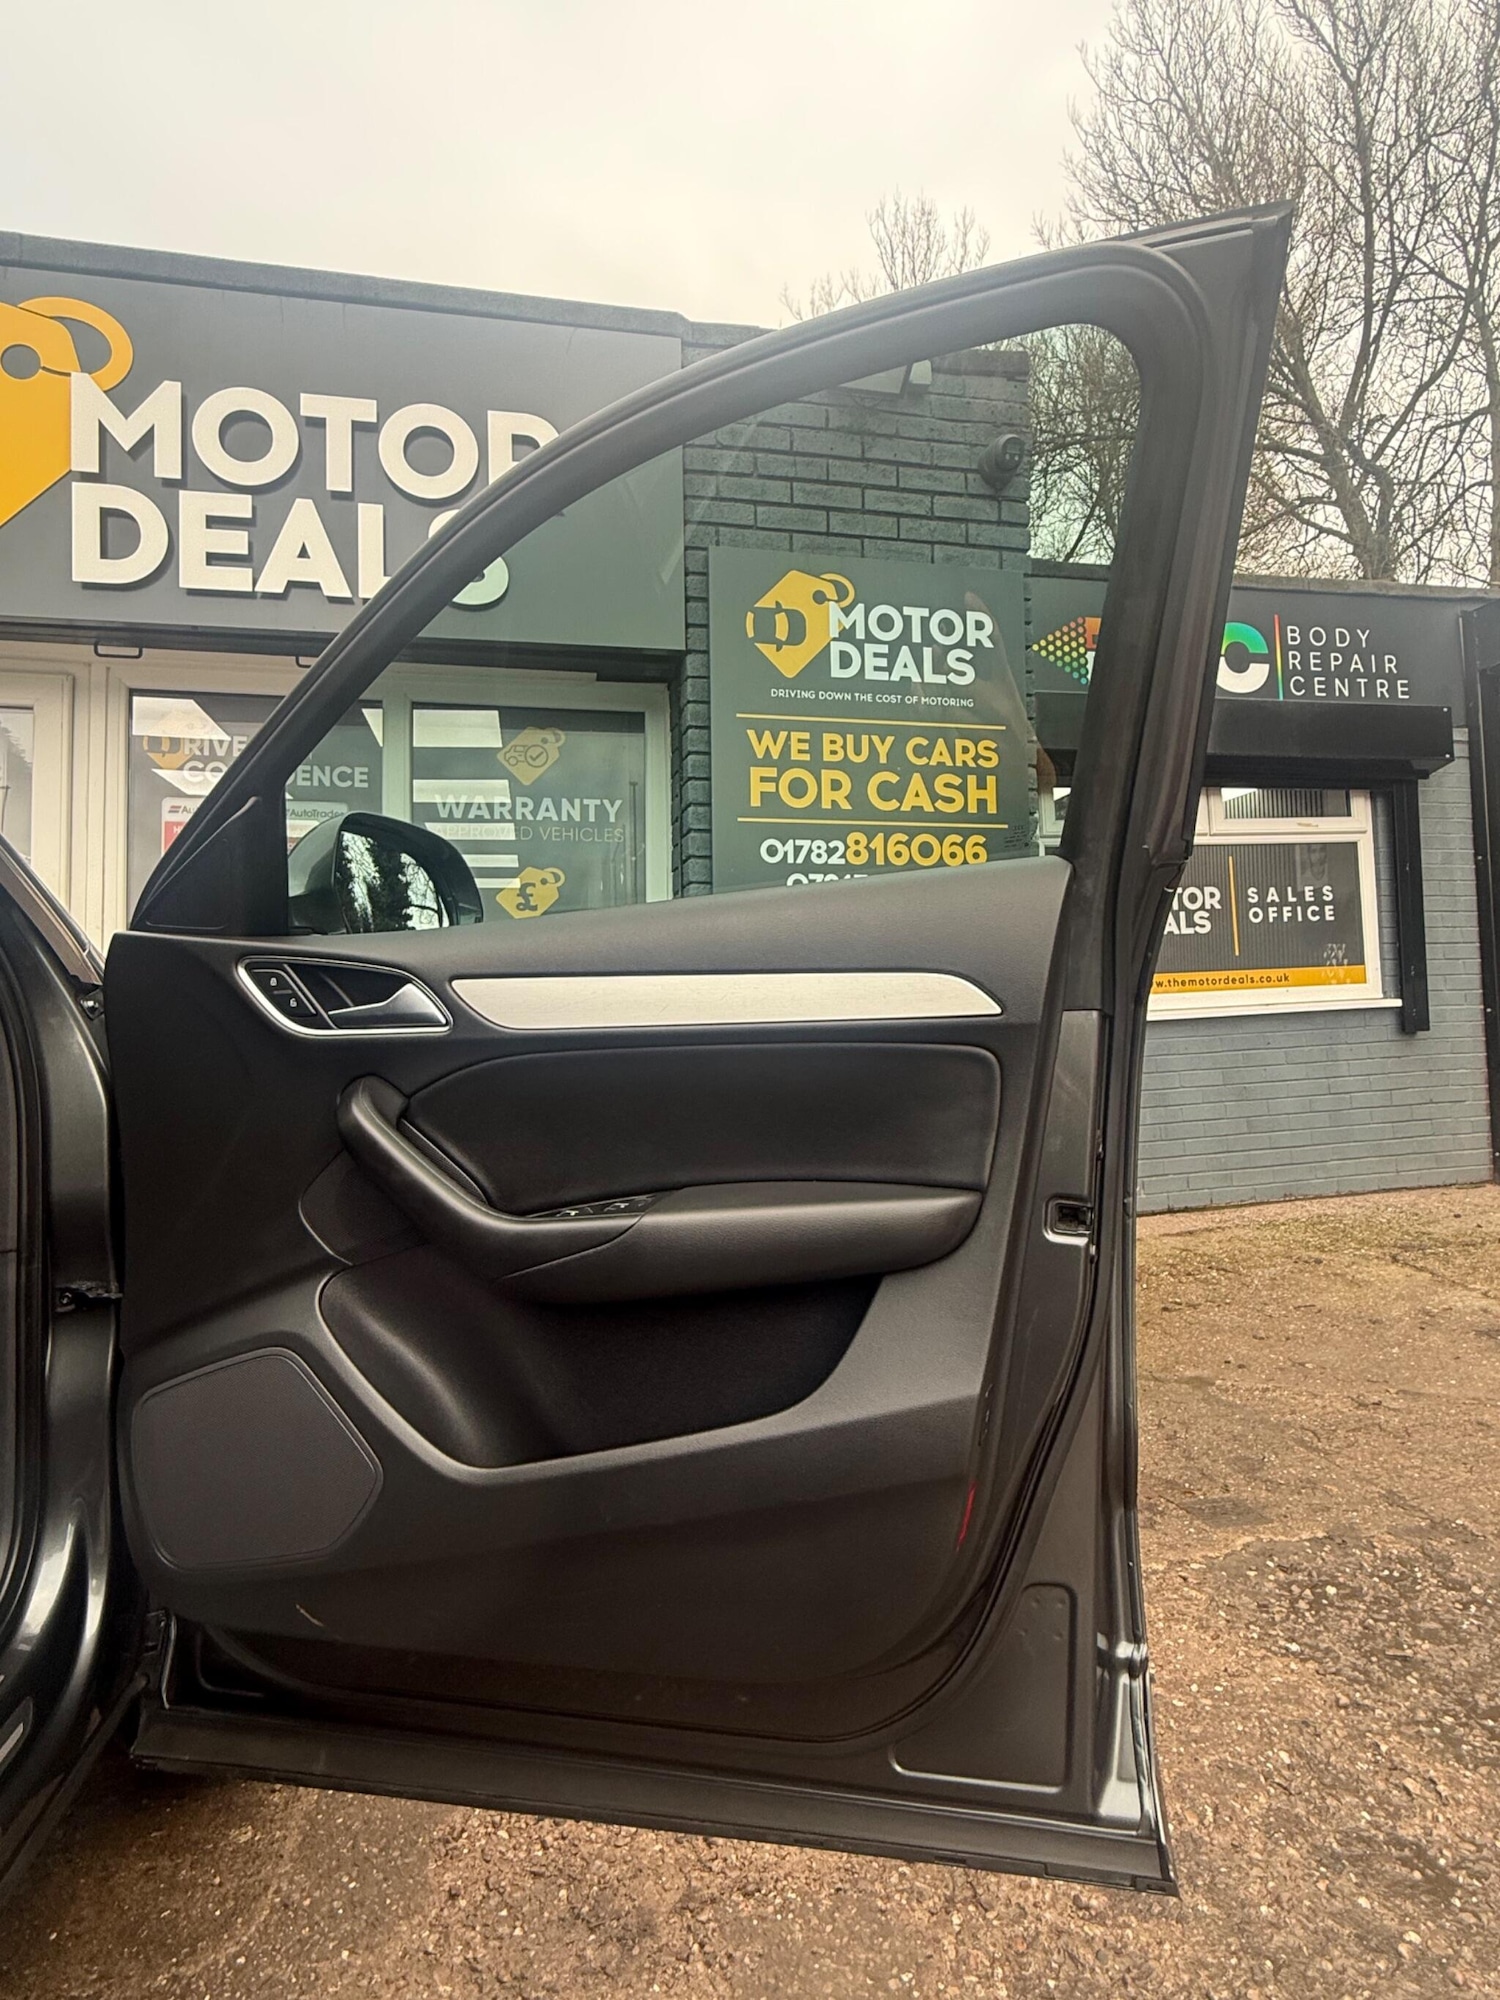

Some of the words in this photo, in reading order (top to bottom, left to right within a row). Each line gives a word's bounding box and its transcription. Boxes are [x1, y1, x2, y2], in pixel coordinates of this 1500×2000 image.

[828, 601, 994, 648] MOTOR
[1287, 625, 1370, 648] BODY
[830, 641, 975, 685] DEALS
[1288, 651, 1398, 674] REPAIR
[771, 688, 816, 699] DRIVING
[818, 691, 852, 701] DOWN
[854, 693, 873, 702] THE
[875, 694, 902, 704] COST
[905, 696, 919, 704] OF
[921, 697, 974, 707] MOTORING
[1290, 676, 1410, 699] CENTRE
[747, 729, 810, 761] WE
[822, 732, 894, 764] BUY
[905, 737, 999, 768] CARS
[750, 767, 852, 809] FOR
[867, 771, 997, 814] CASH
[434, 794, 623, 823] WARRANTY
[434, 823, 533, 841] APPROVED
[539, 826, 625, 843] VEHICLES
[1172, 886, 1222, 911] TOR
[1247, 885, 1334, 903] SALES
[1164, 911, 1212, 935] ALS
[1248, 905, 1335, 923] OFFICE
